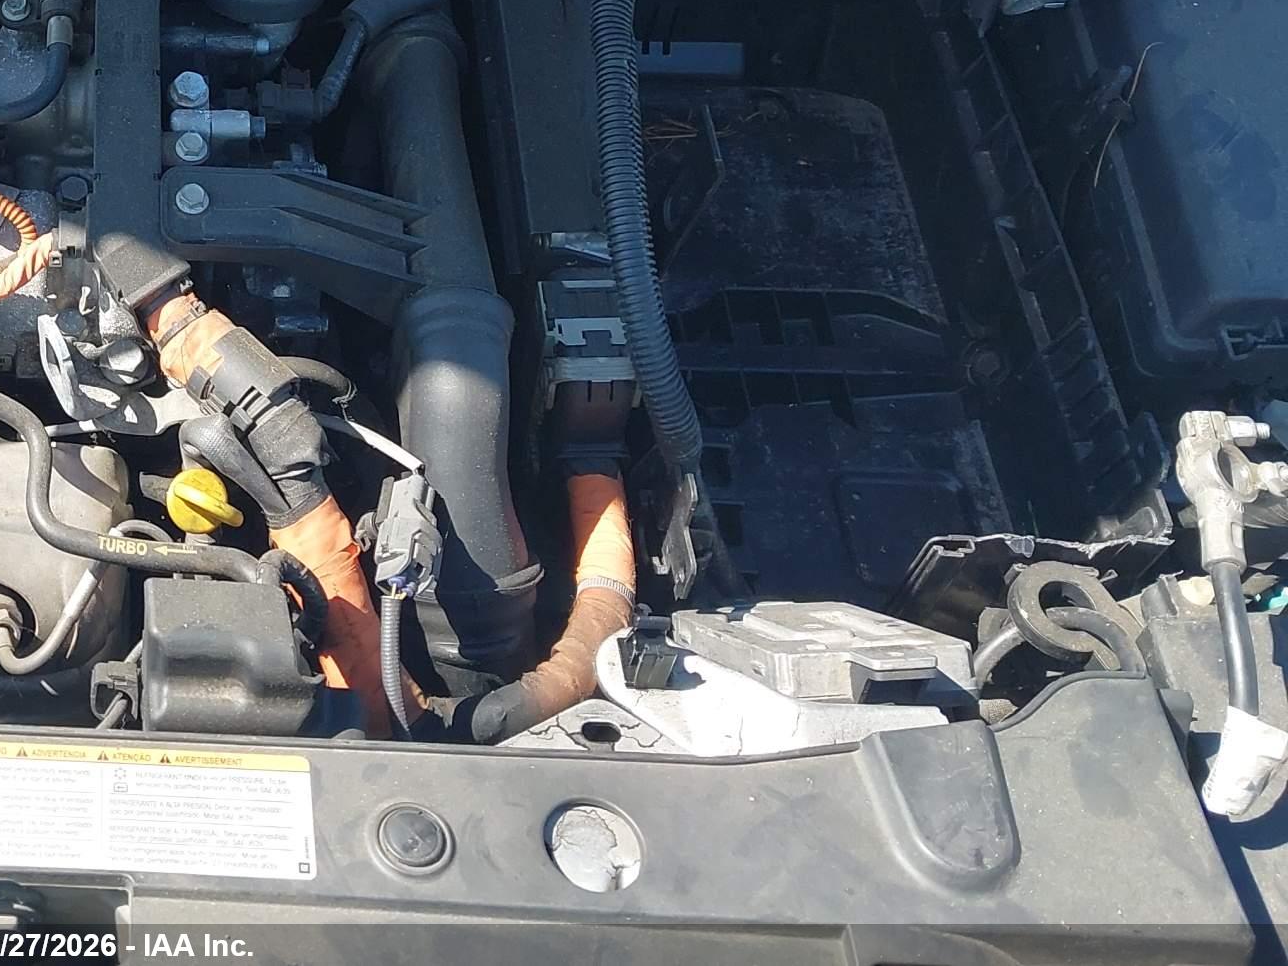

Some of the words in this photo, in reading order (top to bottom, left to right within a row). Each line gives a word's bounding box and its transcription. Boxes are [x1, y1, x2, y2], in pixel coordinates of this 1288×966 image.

[97, 535, 148, 556] TURBO
[111, 751, 152, 763] ATENÇÃO
[174, 754, 243, 767] AVERTISSEMENT
